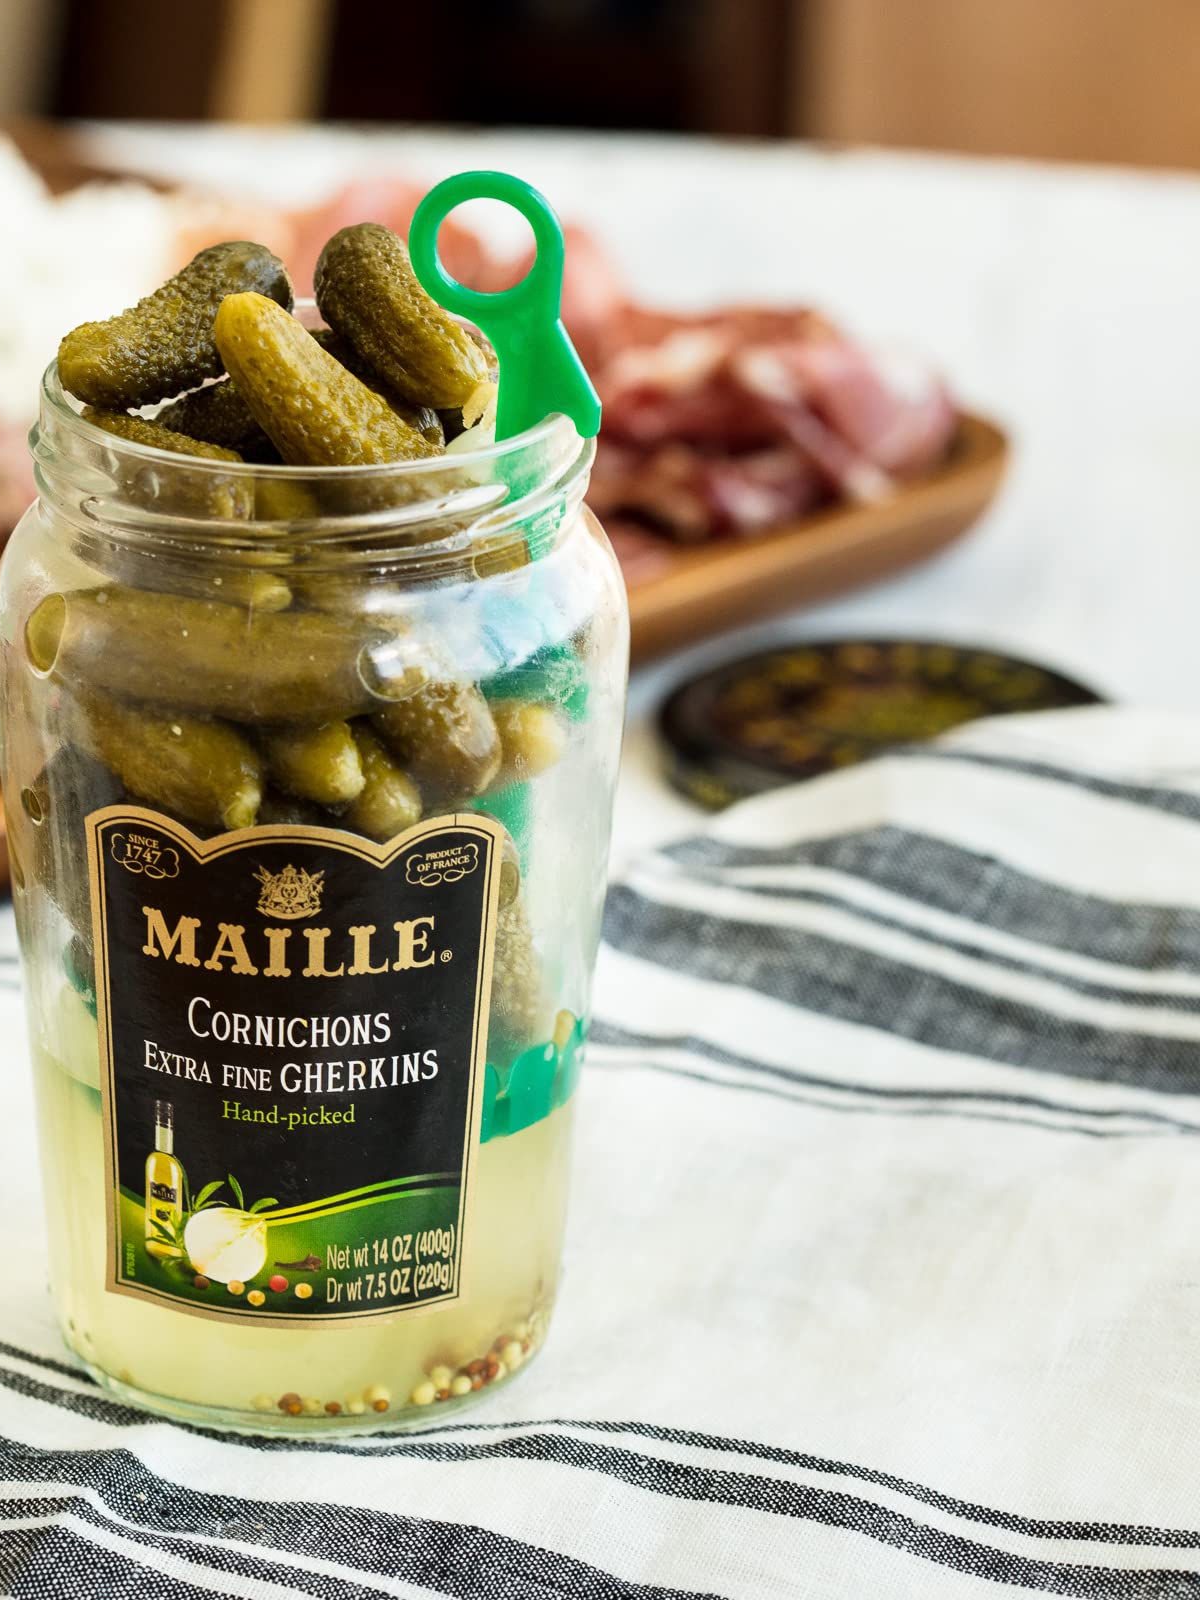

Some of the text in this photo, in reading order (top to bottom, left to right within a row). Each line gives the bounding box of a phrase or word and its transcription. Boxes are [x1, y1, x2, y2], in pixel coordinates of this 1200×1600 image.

[125, 843, 162, 865] 1747
[128, 833, 160, 849] SINCE
[425, 846, 463, 861] PRODUCT
[416, 854, 471, 873] OF FRANCE
[221, 1064, 273, 1092] FINE
[280, 1049, 439, 1093] GHERKINS
[221, 1100, 356, 1131] Hand-picked
[326, 1223, 455, 1270] Net wt 14 OZ (400g)
[326, 1257, 454, 1303] Dr wt 7.5 OZ (220g)
